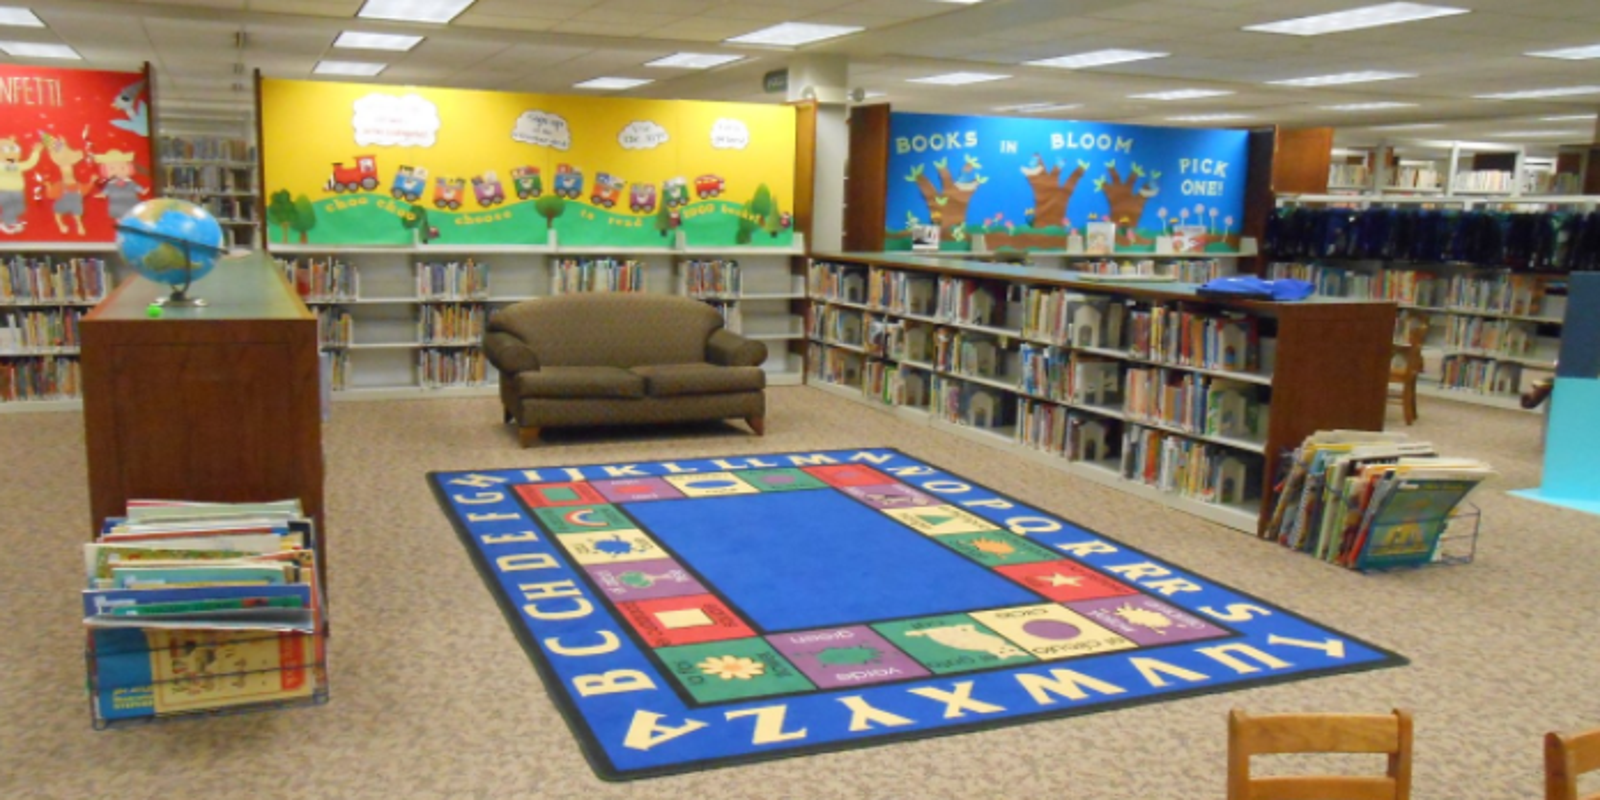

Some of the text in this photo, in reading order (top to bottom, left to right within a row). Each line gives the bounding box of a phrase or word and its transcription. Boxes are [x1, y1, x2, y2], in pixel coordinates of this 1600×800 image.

[895, 130, 1134, 154] BOOKS IN BLOOM
[1178, 157, 1229, 177] PICK
[1180, 179, 1224, 197] ONE!
[608, 216, 643, 227] read
[450, 474, 507, 488] H
[521, 470, 543, 482] I
[562, 467, 587, 483] J
[603, 465, 648, 477] K
[661, 462, 698, 473] L
[786, 453, 840, 467] M
[848, 451, 894, 464] N
[453, 492, 507, 504] G
[466, 512, 522, 523] F
[480, 530, 539, 544] E
[921, 480, 972, 494] O
[959, 498, 1015, 509] P
[1005, 516, 1063, 536] Q
[1054, 540, 1118, 557] R
[1198, 602, 1272, 623] S
[495, 552, 561, 572] D
[995, 607, 1047, 619] circle
[544, 630, 622, 657] C
[789, 629, 855, 644] green
[571, 668, 658, 698] B
[836, 667, 903, 681] verde
[622, 634, 1346, 752] A Z Y X W V U T
